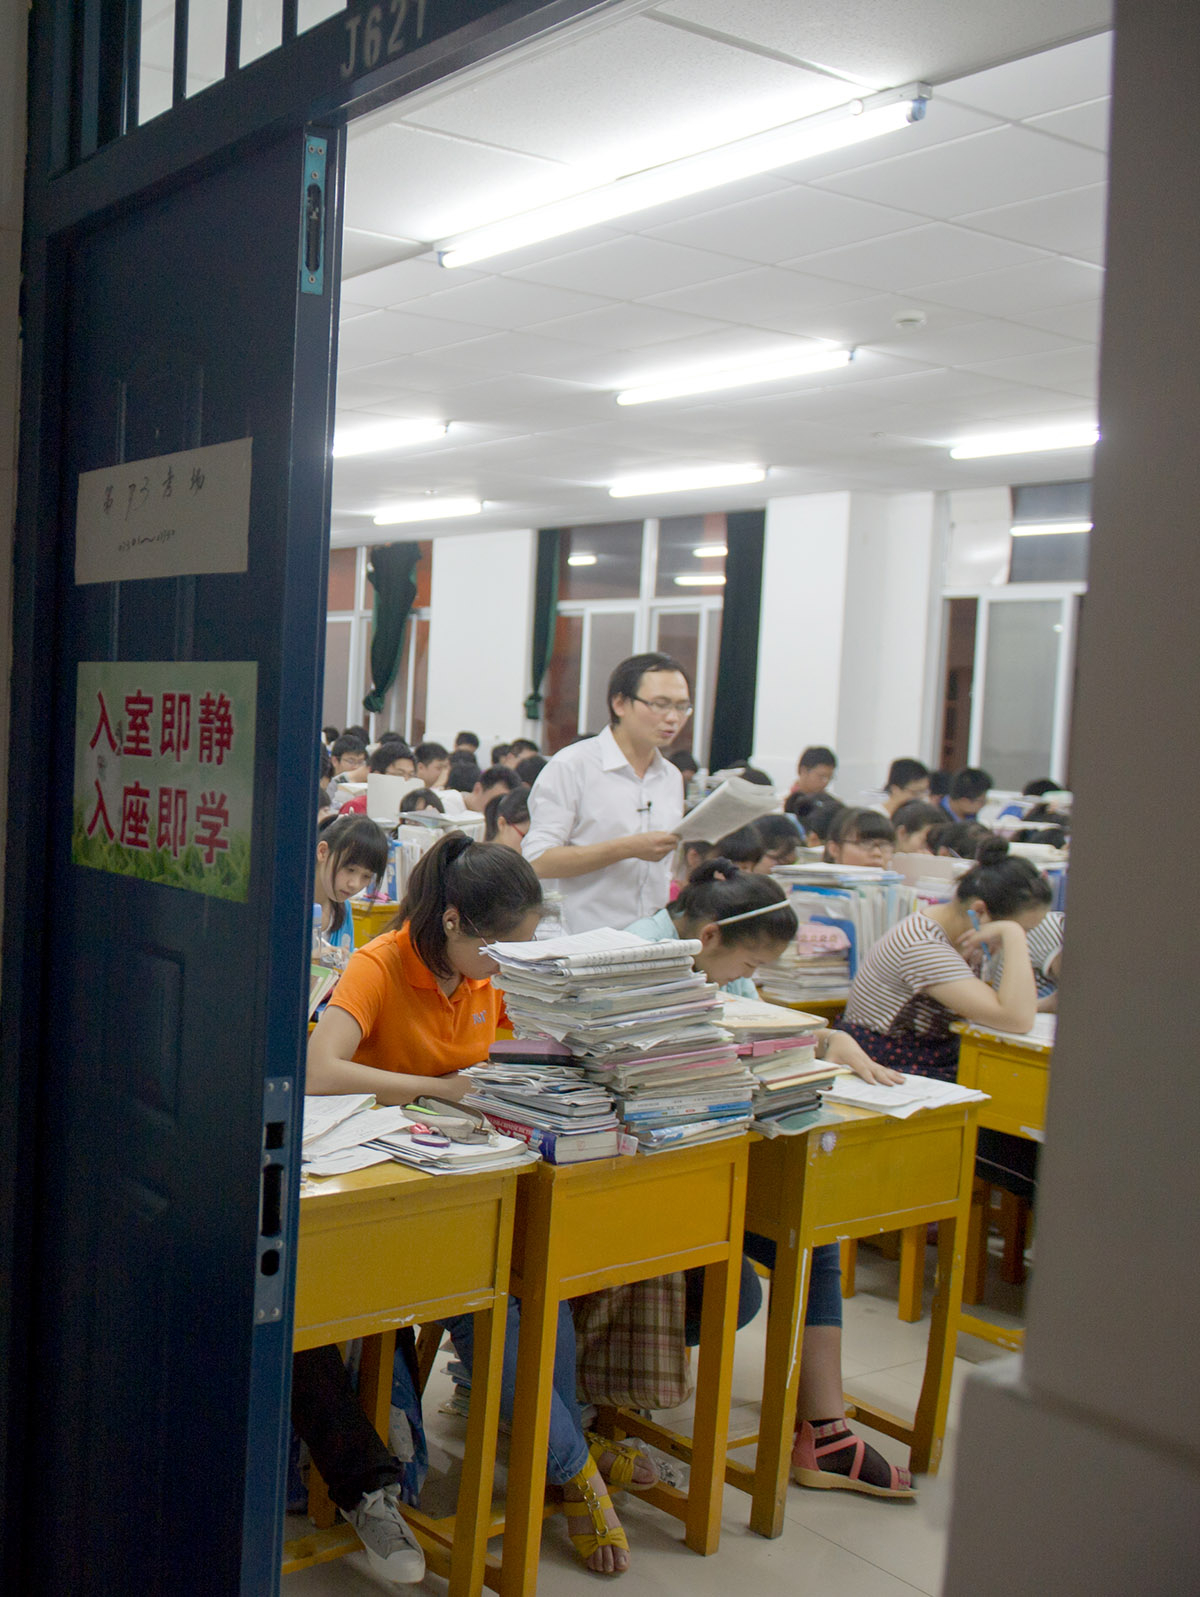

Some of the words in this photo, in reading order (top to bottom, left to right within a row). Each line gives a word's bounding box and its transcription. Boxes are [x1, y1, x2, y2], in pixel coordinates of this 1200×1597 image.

[340, 0, 427, 78] J621
[88, 689, 234, 766] 入室即静
[86, 779, 230, 866] 入座即学
